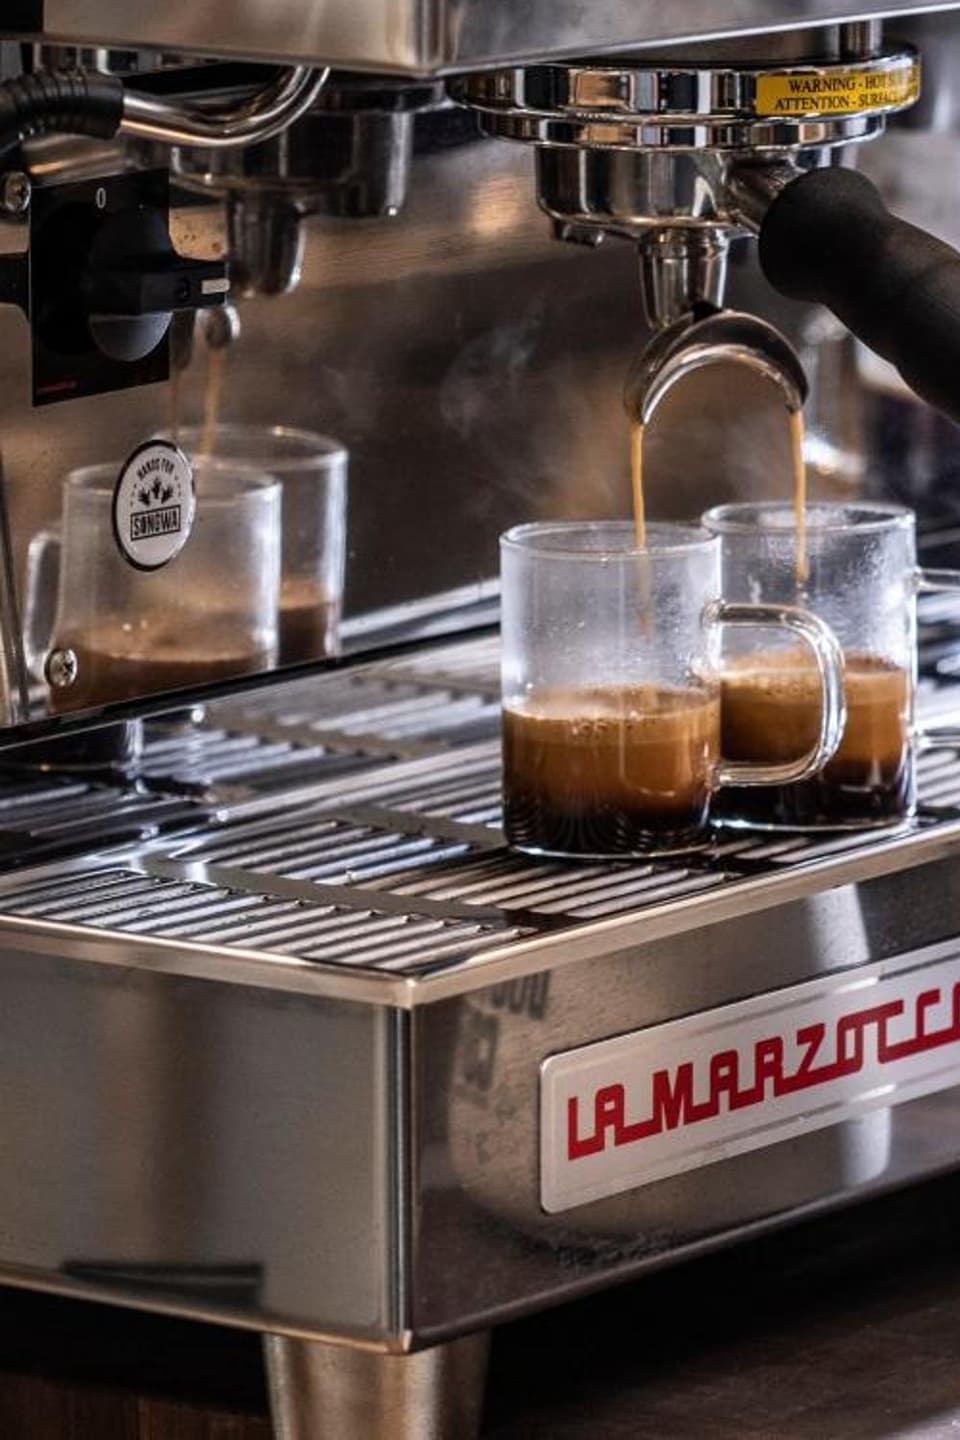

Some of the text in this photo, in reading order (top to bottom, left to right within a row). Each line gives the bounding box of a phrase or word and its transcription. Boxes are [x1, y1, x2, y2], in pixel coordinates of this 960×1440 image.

[788, 76, 856, 93] WARNING
[775, 95, 849, 111] ATTENTION
[568, 1083, 626, 1161] LA
